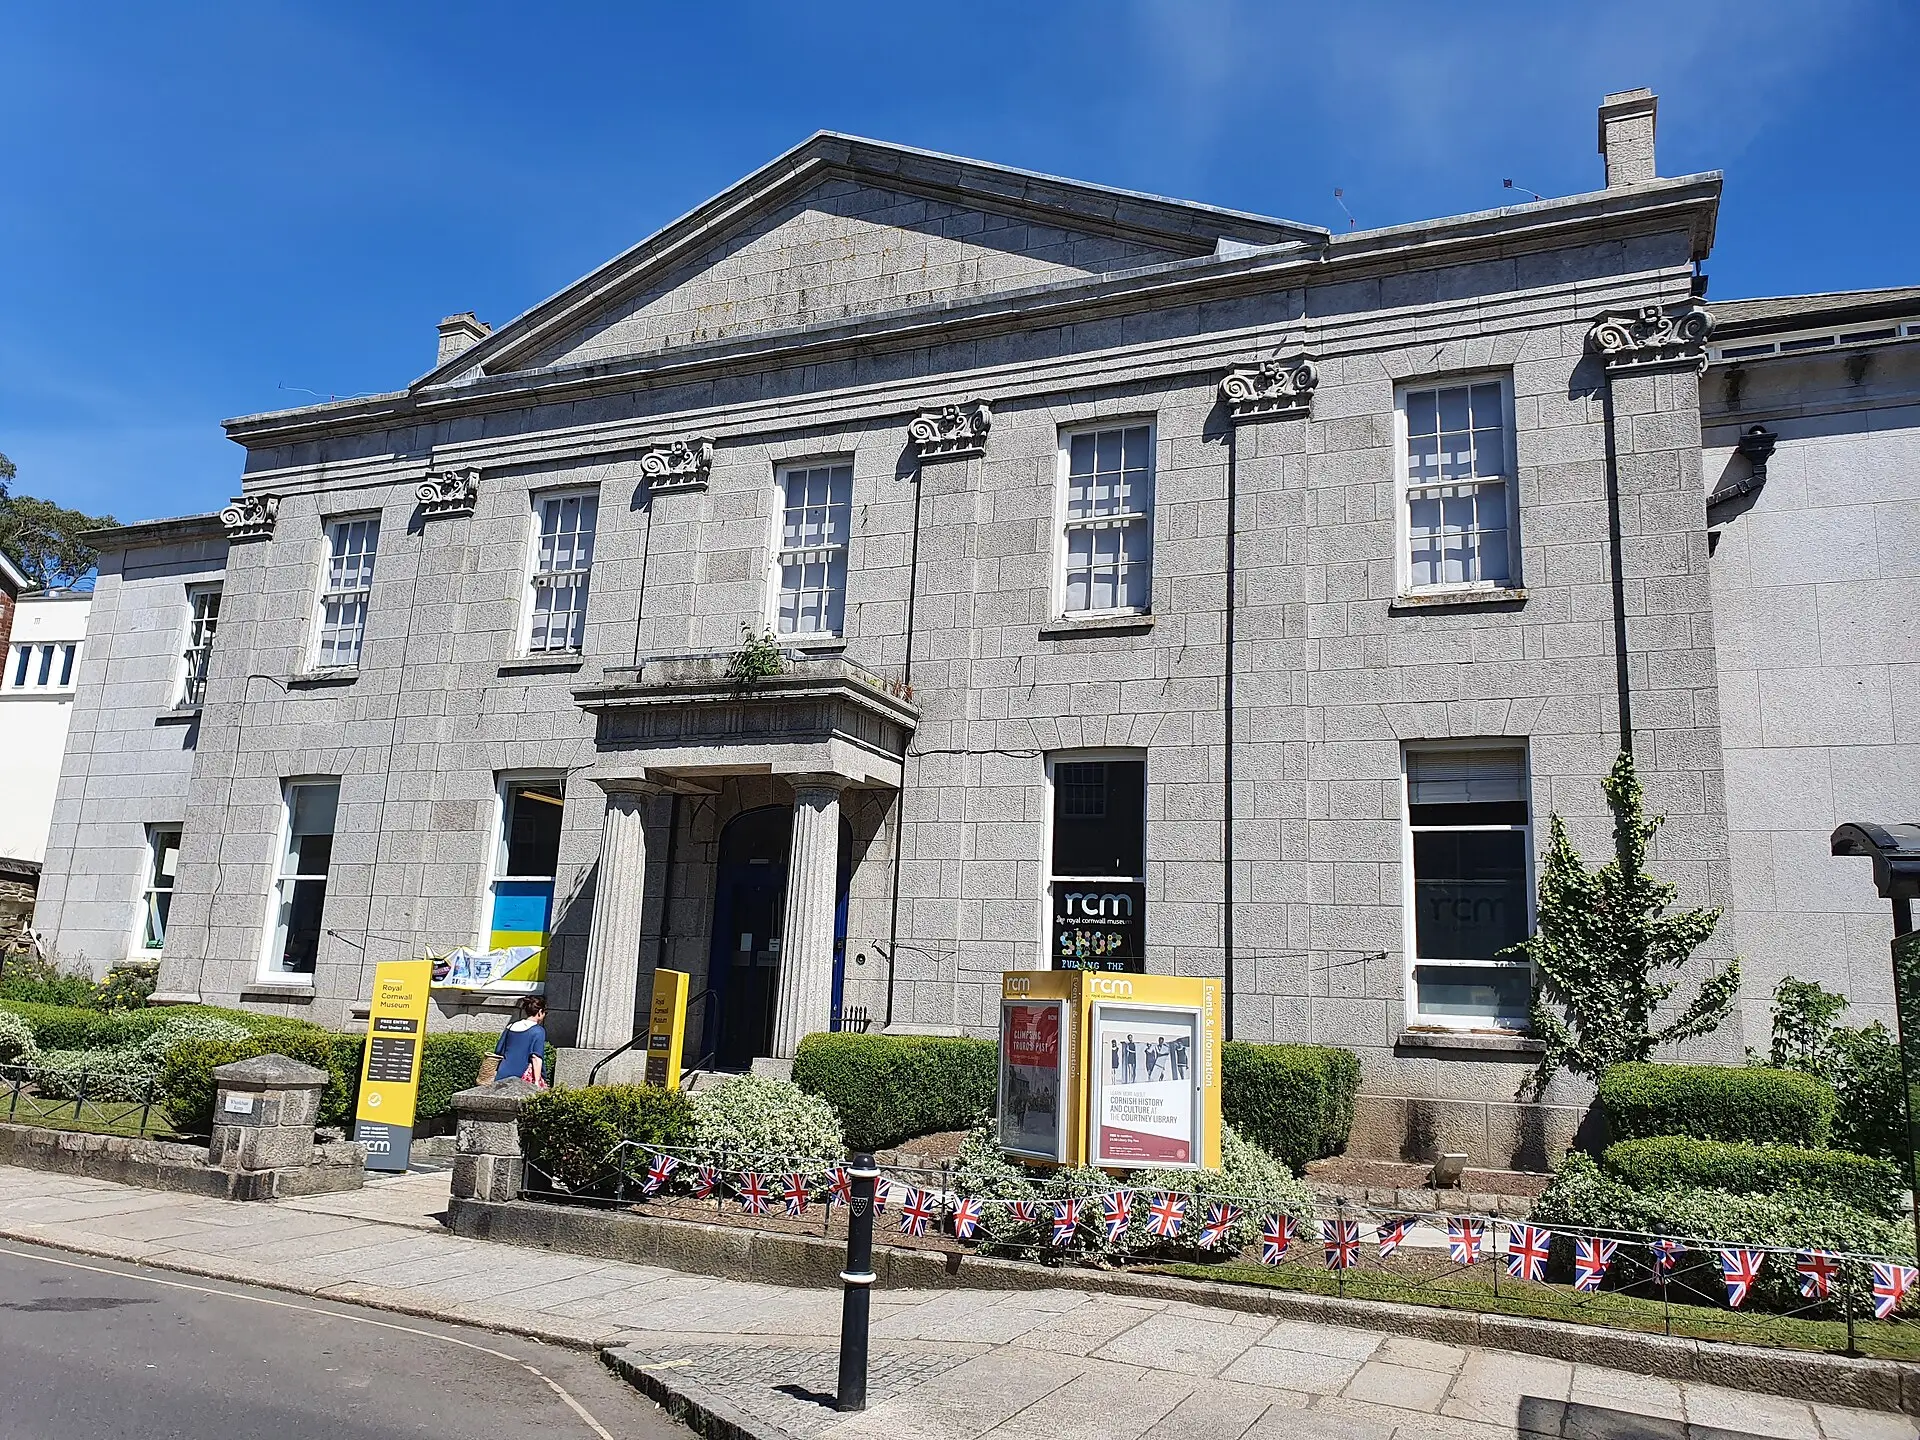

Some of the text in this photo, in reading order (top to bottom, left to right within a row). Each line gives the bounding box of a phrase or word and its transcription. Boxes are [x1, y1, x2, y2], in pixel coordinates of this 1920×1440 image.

[1064, 892, 1133, 917] rcm
[1066, 917, 1081, 925] royal
[1082, 917, 1106, 925] cornwall
[1060, 930, 1122, 956] SHOP
[1107, 961, 1124, 970] THE
[382, 984, 402, 992] Royal
[1006, 977, 1030, 991] rcm
[1089, 978, 1132, 995] rcm
[381, 993, 412, 1001] Cornwall
[380, 1001, 410, 1009] Museum
[1205, 985, 1215, 1088] Events & Information
[1035, 1042, 1049, 1053] PAST
[1071, 1020, 1079, 1079] Information
[1110, 1096, 1164, 1107] CORNISH HISTORY
[1110, 1105, 1123, 1113] AND
[1123, 1105, 1150, 1114] CULTURE
[1121, 1114, 1153, 1122] COURTNEY
[1153, 1115, 1178, 1124] LIBRARY
